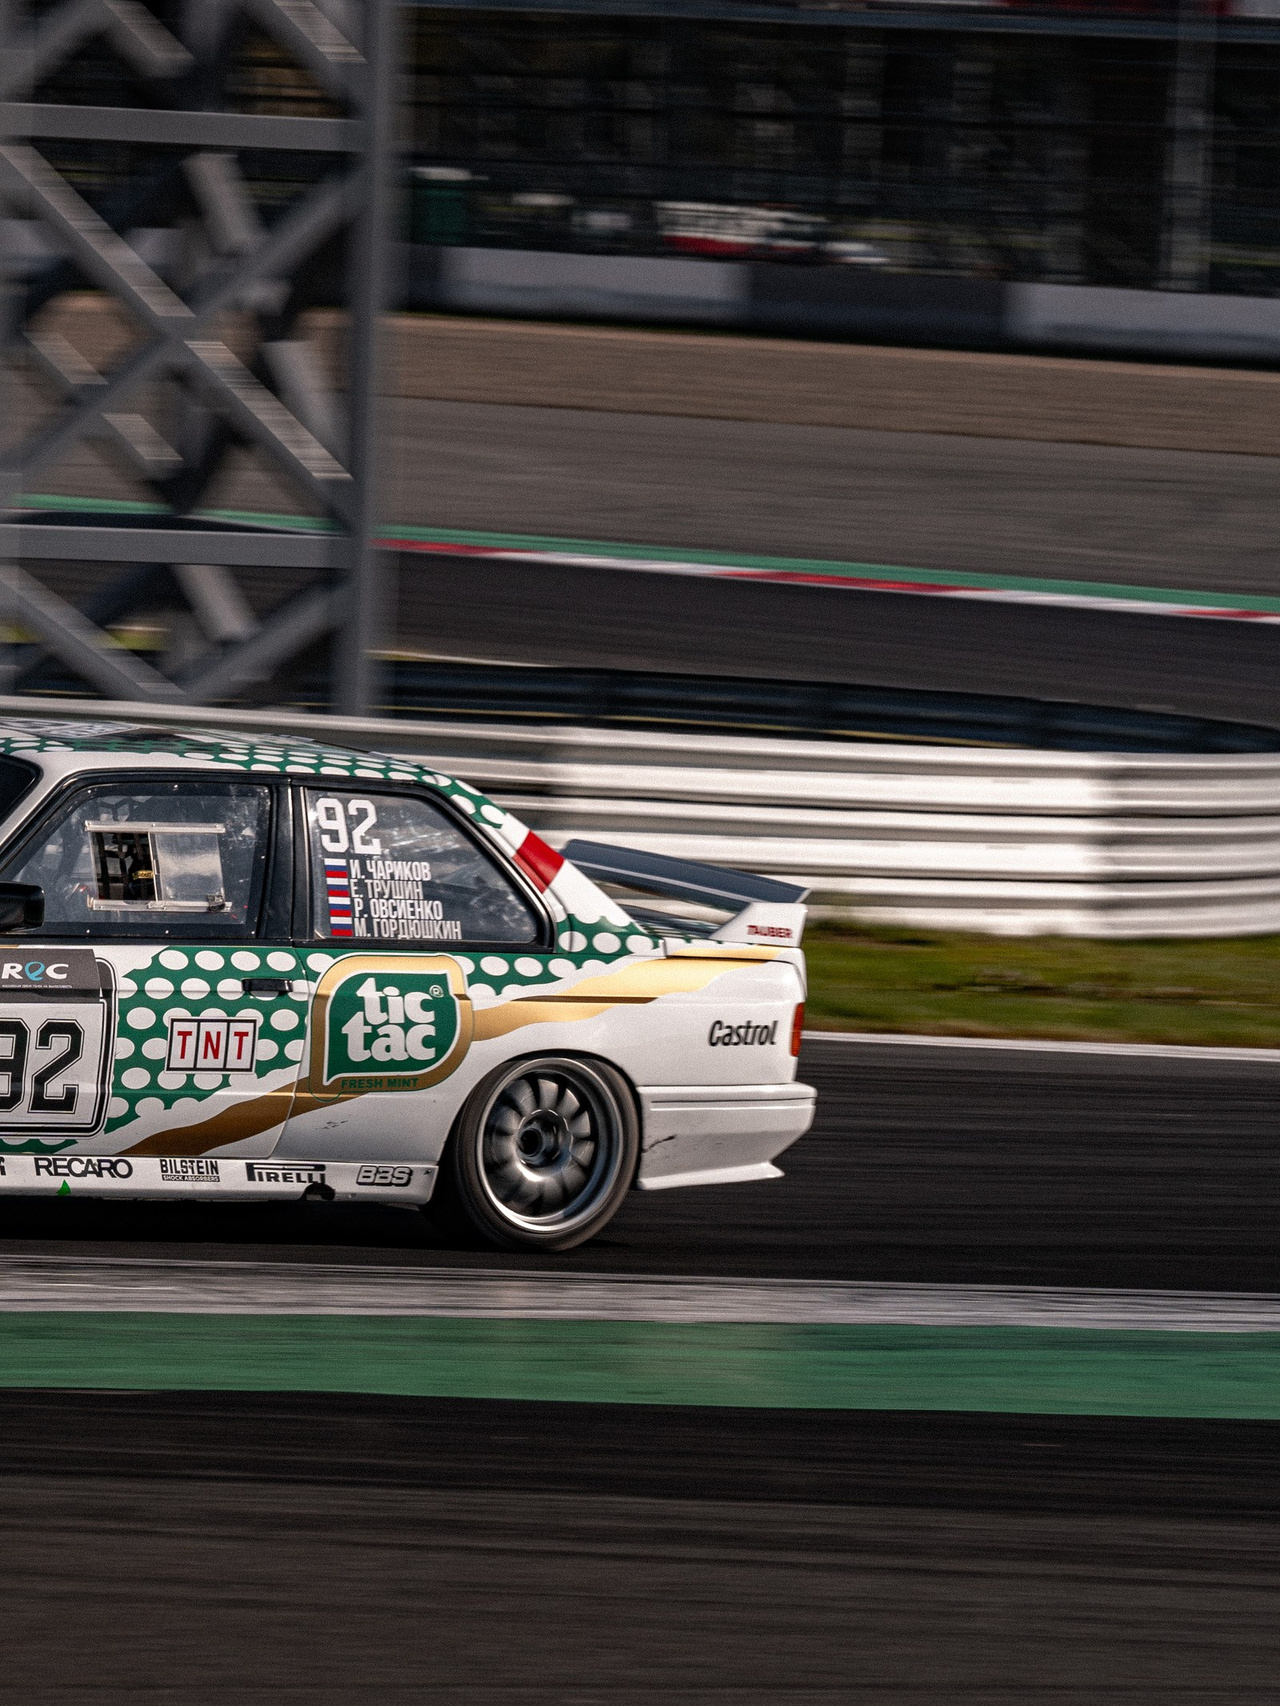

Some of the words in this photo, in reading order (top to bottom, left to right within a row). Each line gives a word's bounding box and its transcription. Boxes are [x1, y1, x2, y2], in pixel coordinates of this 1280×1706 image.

[316, 797, 382, 855] 92
[349, 859, 366, 879] И.
[366, 860, 432, 881] ЧАРИКОВ
[349, 879, 364, 898] Е.
[364, 879, 424, 900] ТРУШИН
[353, 898, 369, 918] Р.
[370, 898, 443, 920] ОВСИЕНКО
[354, 917, 371, 938] М.
[373, 918, 462, 940] ГОРДЮШКИН
[746, 924, 794, 939] TAUBER
[355, 977, 436, 1025] tic
[341, 1011, 437, 1063] tac
[708, 1019, 780, 1047] Castrol
[176, 1030, 250, 1061] TNT
[340, 1077, 384, 1090] FRESH
[385, 1076, 420, 1089] MINT
[33, 1156, 134, 1180] RECARO
[159, 1158, 220, 1176] BILSTEIN
[163, 1174, 183, 1182] SHOCK
[184, 1175, 219, 1183] ABSORBERS
[245, 1161, 327, 1185] PIRELLI
[355, 1164, 414, 1187] BBS
